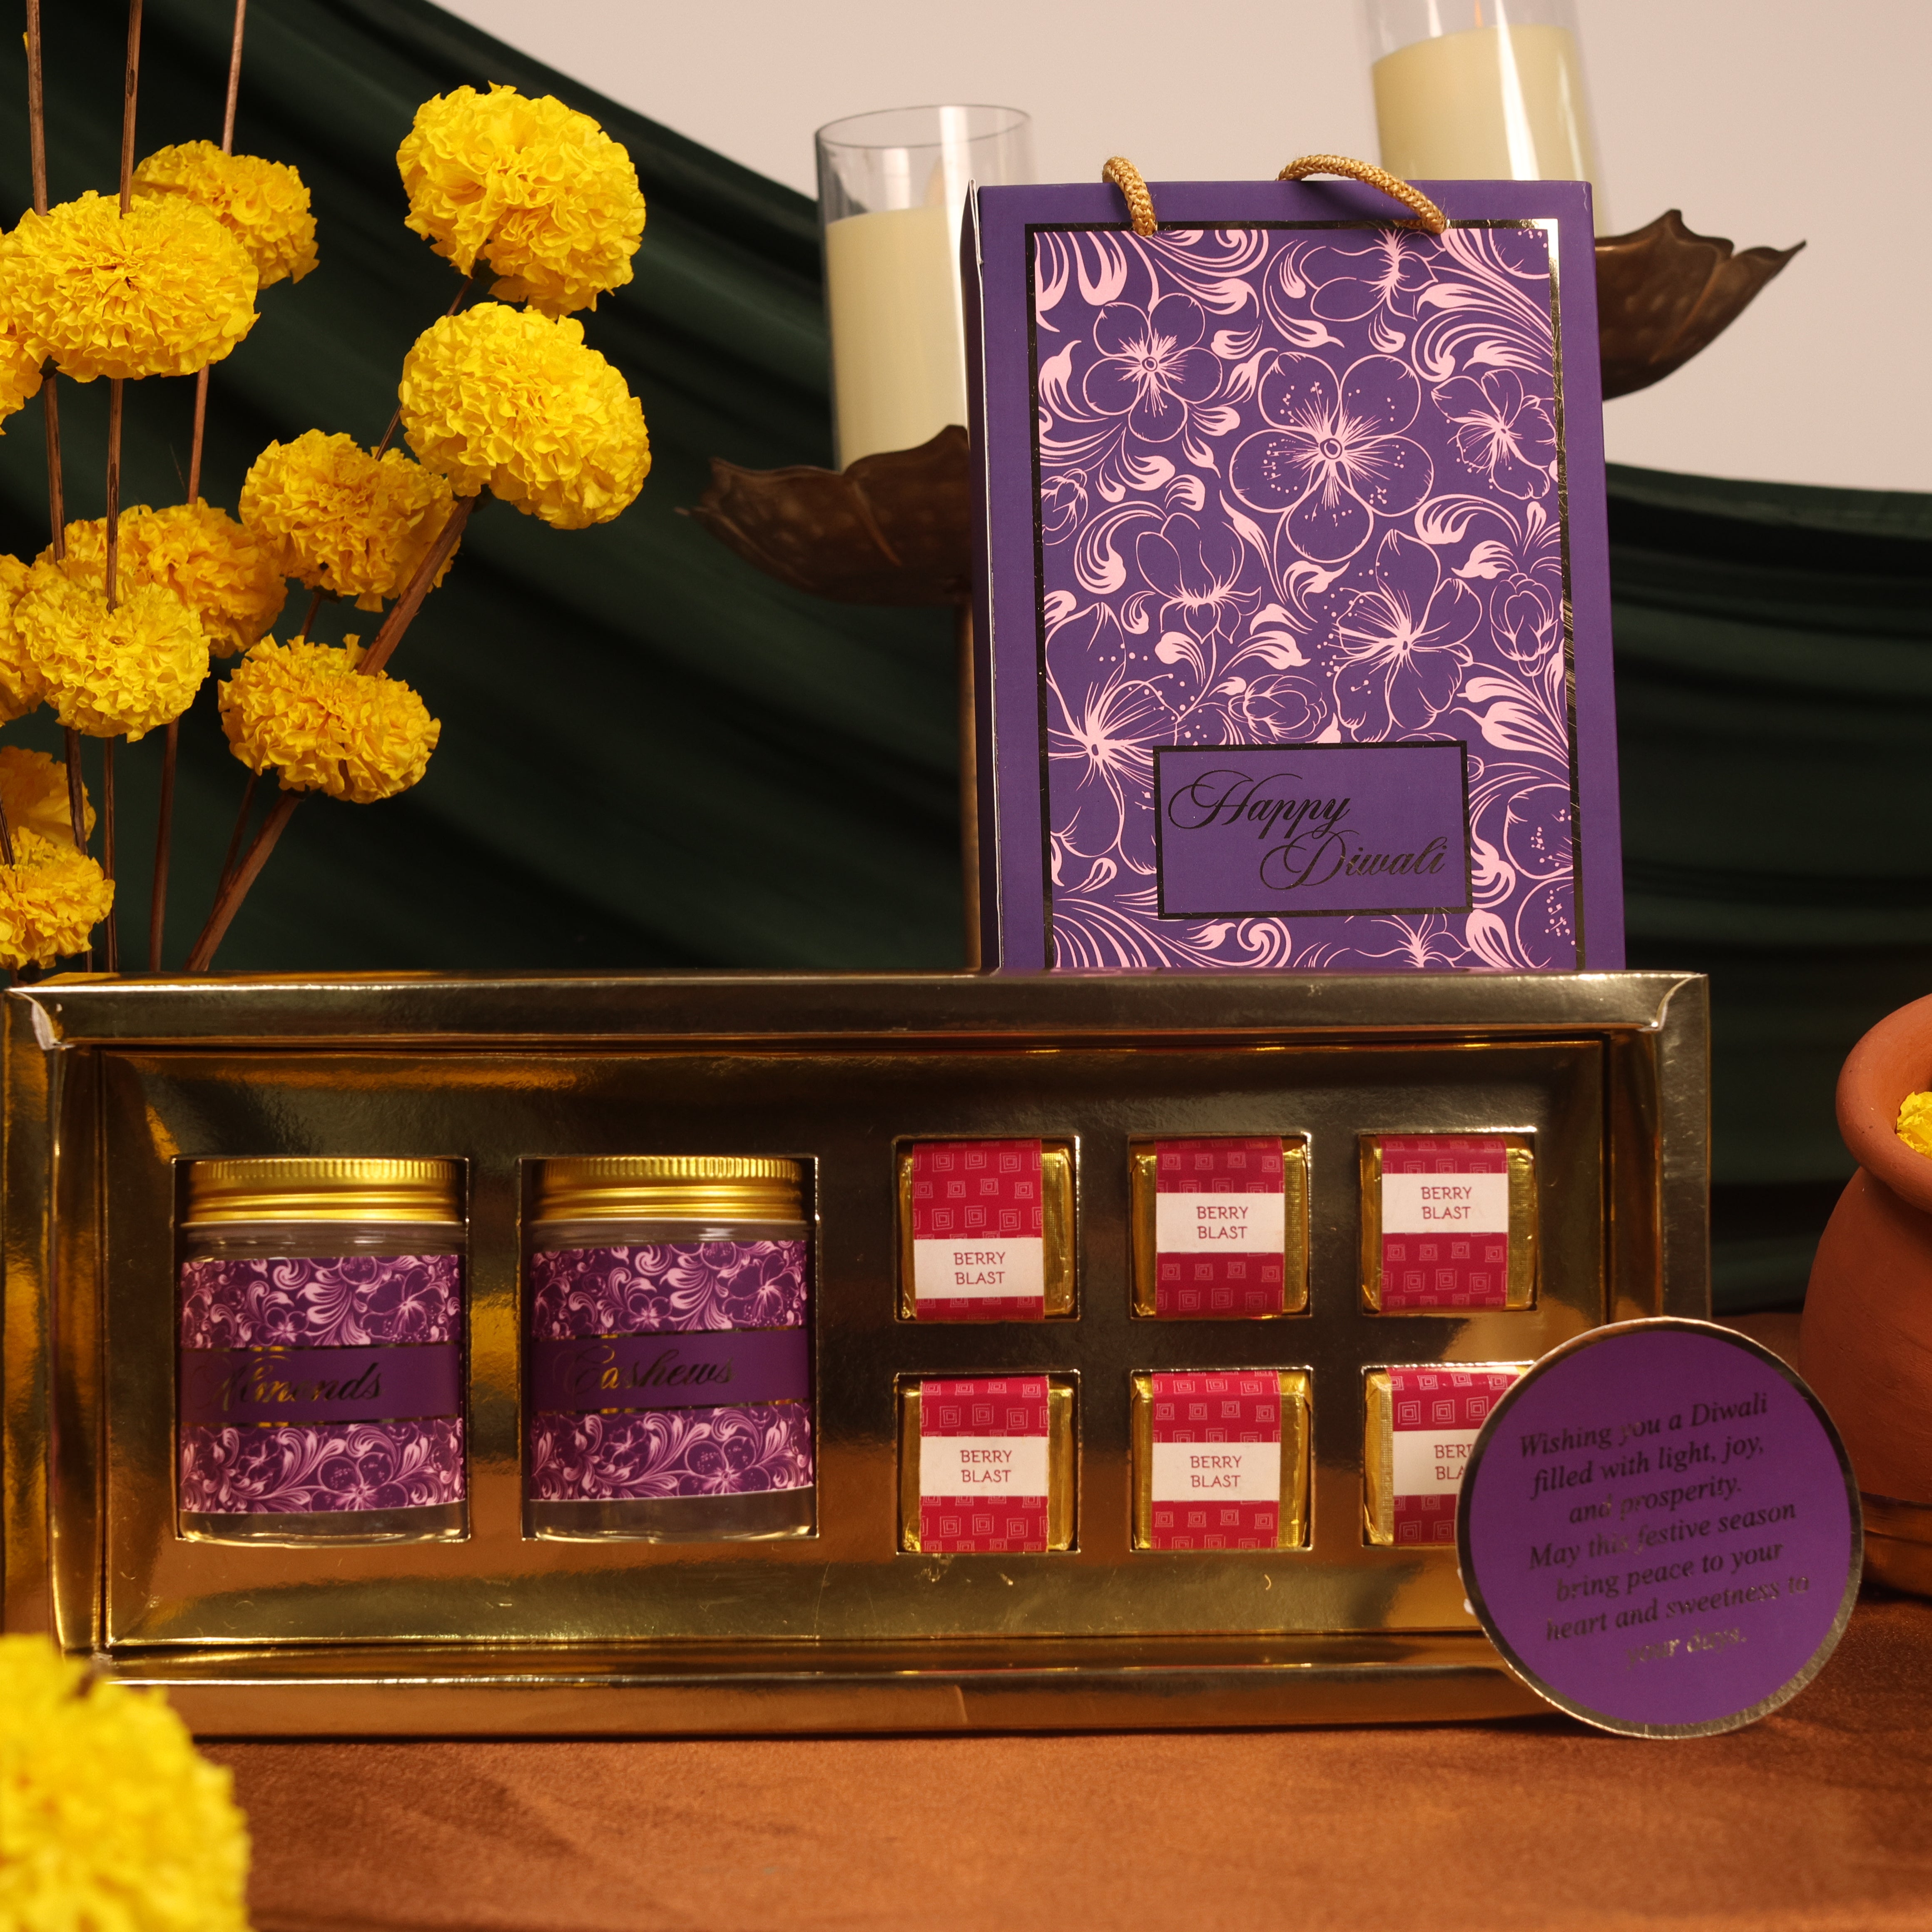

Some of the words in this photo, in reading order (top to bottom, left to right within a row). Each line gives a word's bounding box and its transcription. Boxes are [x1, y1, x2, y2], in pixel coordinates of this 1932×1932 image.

[1168, 769, 1350, 839] Happy
[1259, 829, 1448, 890] Diwali
[1421, 1187, 1471, 1200] BERRY
[1196, 1206, 1248, 1219] BERRY
[1422, 1206, 1471, 1219] BLAST
[1197, 1226, 1247, 1239] BLAST
[953, 1252, 1005, 1265] BERRY
[954, 1271, 1005, 1285] BLAST
[553, 1344, 736, 1395] Cashews
[189, 1354, 383, 1412] Almonds
[1519, 1427, 1611, 1457] Wishing
[1618, 1417, 1661, 1447] you
[1669, 1414, 1682, 1431] a
[1691, 1392, 1768, 1428] Diwali
[960, 1450, 1012, 1463] BERRY
[1434, 1444, 1472, 1459] BER
[1190, 1456, 1241, 1468] BERRY
[1531, 1460, 1593, 1501] filled
[1601, 1451, 1650, 1480] with
[1658, 1441, 1716, 1473] light,
[1722, 1435, 1764, 1464] joy,
[961, 1469, 1011, 1483] BLAST
[1435, 1465, 1464, 1480] BLA
[1190, 1475, 1240, 1488] BLAST
[1569, 1494, 1613, 1524] and
[1620, 1476, 1742, 1521] prosperity.
[1529, 1543, 1581, 1570] May
[1588, 1533, 1629, 1559] this
[1634, 1519, 1710, 1555] festive
[1718, 1503, 1797, 1534] season
[1556, 1575, 1620, 1602] bring
[1626, 1560, 1695, 1595] peace
[1702, 1554, 1723, 1573] to
[1730, 1543, 1784, 1573] your
[1546, 1611, 1607, 1641] heart
[1615, 1597, 1658, 1628] and
[1666, 1581, 1780, 1619] sweetness
[1788, 1576, 1810, 1595] to
[1625, 1638, 1681, 1671] your
[1686, 1627, 1747, 1654] days.
